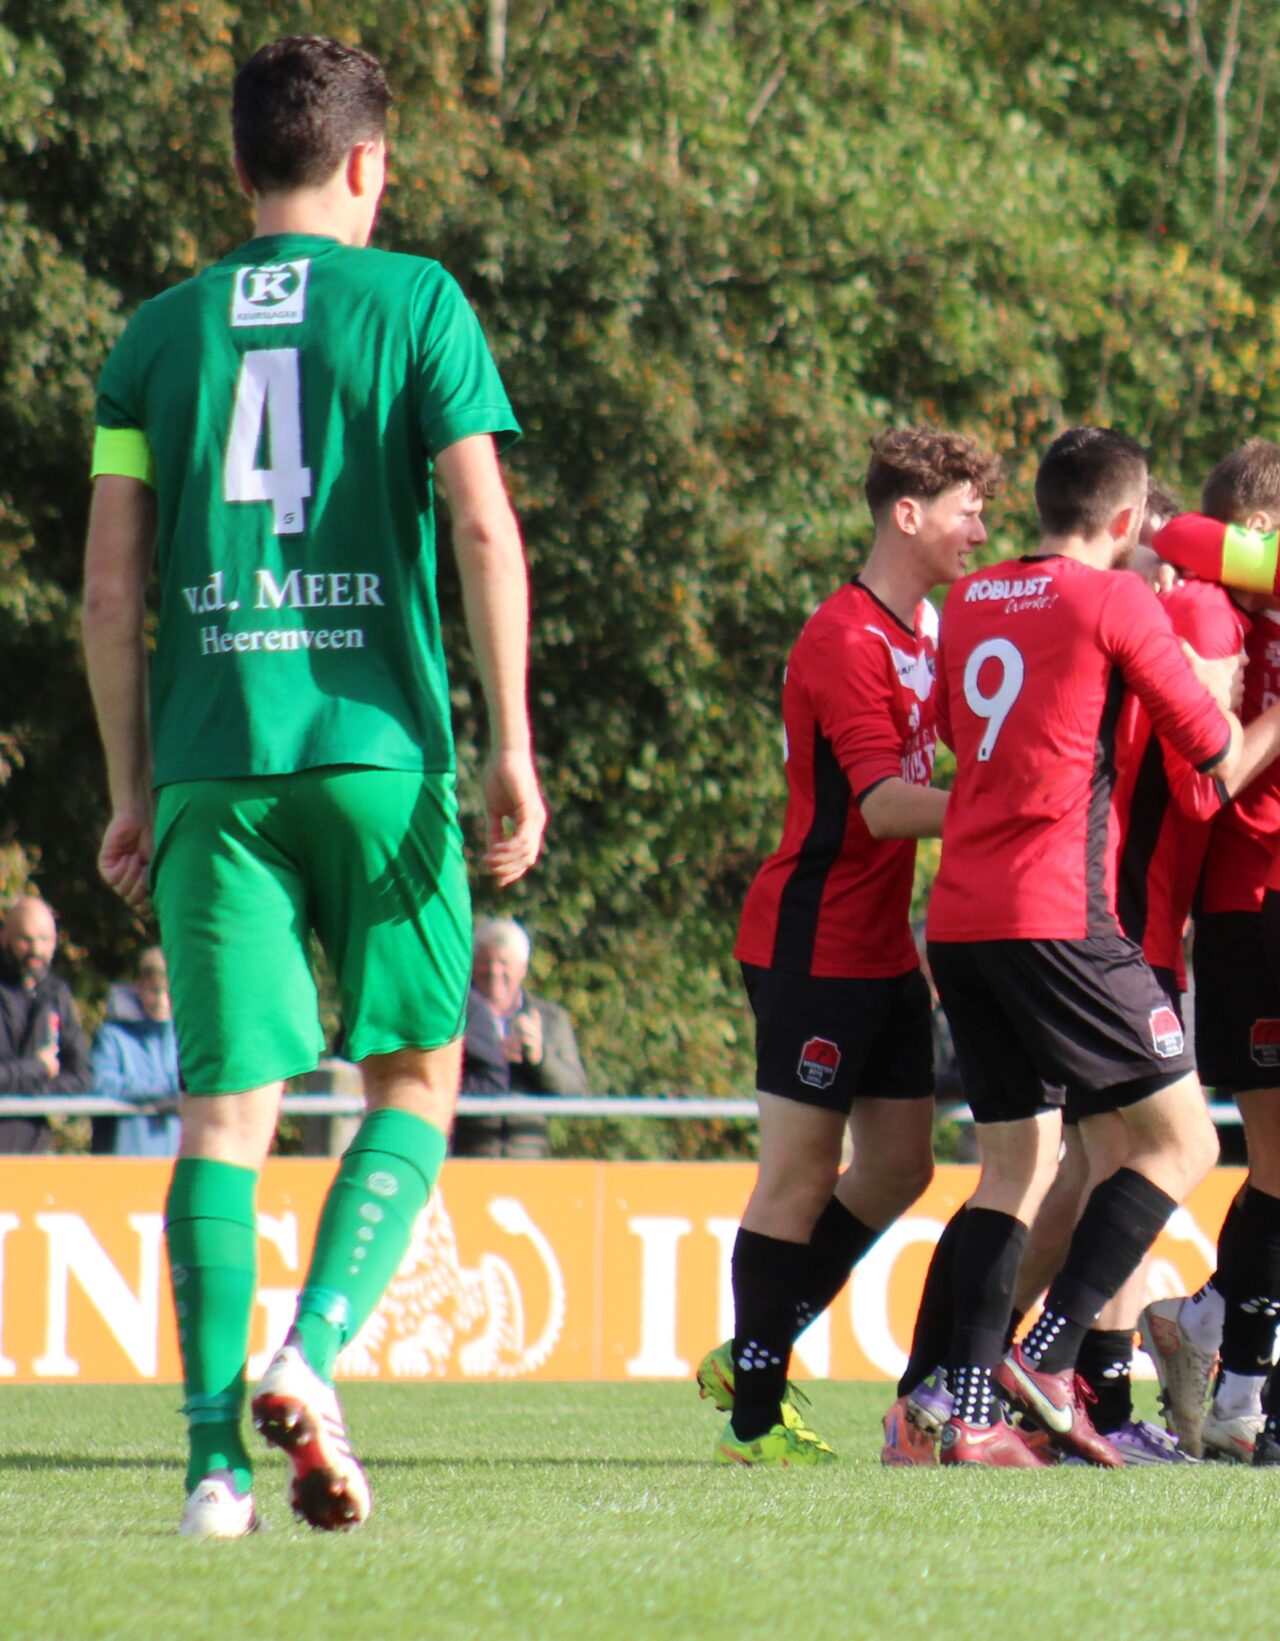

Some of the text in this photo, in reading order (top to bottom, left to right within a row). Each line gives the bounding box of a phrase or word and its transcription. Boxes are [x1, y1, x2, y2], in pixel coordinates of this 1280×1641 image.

[247, 271, 292, 301] K
[224, 347, 312, 535] 4
[254, 568, 386, 609] MEER
[201, 625, 366, 657] Heerenveen
[963, 637, 1025, 762] 9
